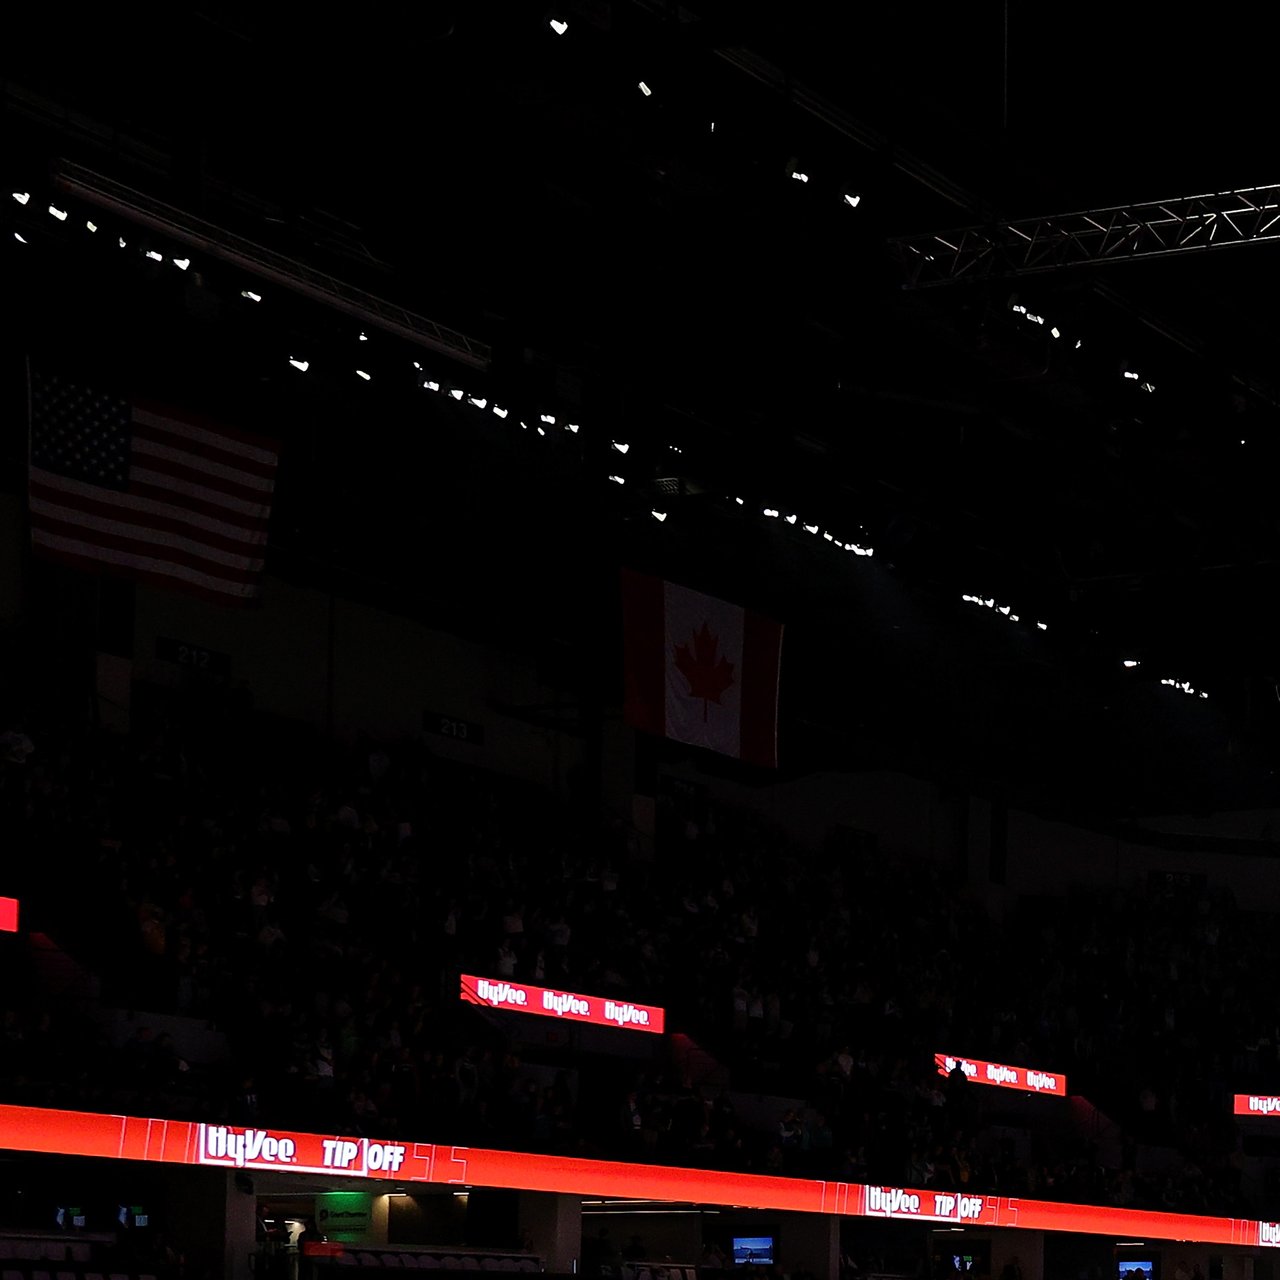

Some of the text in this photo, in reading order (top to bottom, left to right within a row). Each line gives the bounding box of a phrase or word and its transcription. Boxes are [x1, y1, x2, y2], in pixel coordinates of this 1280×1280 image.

[477, 980, 649, 1025] HyVee HyVee HyVee
[208, 1126, 405, 1171] HyVee TIP OFF
[870, 1186, 982, 1218] HyVee TIP OFF
